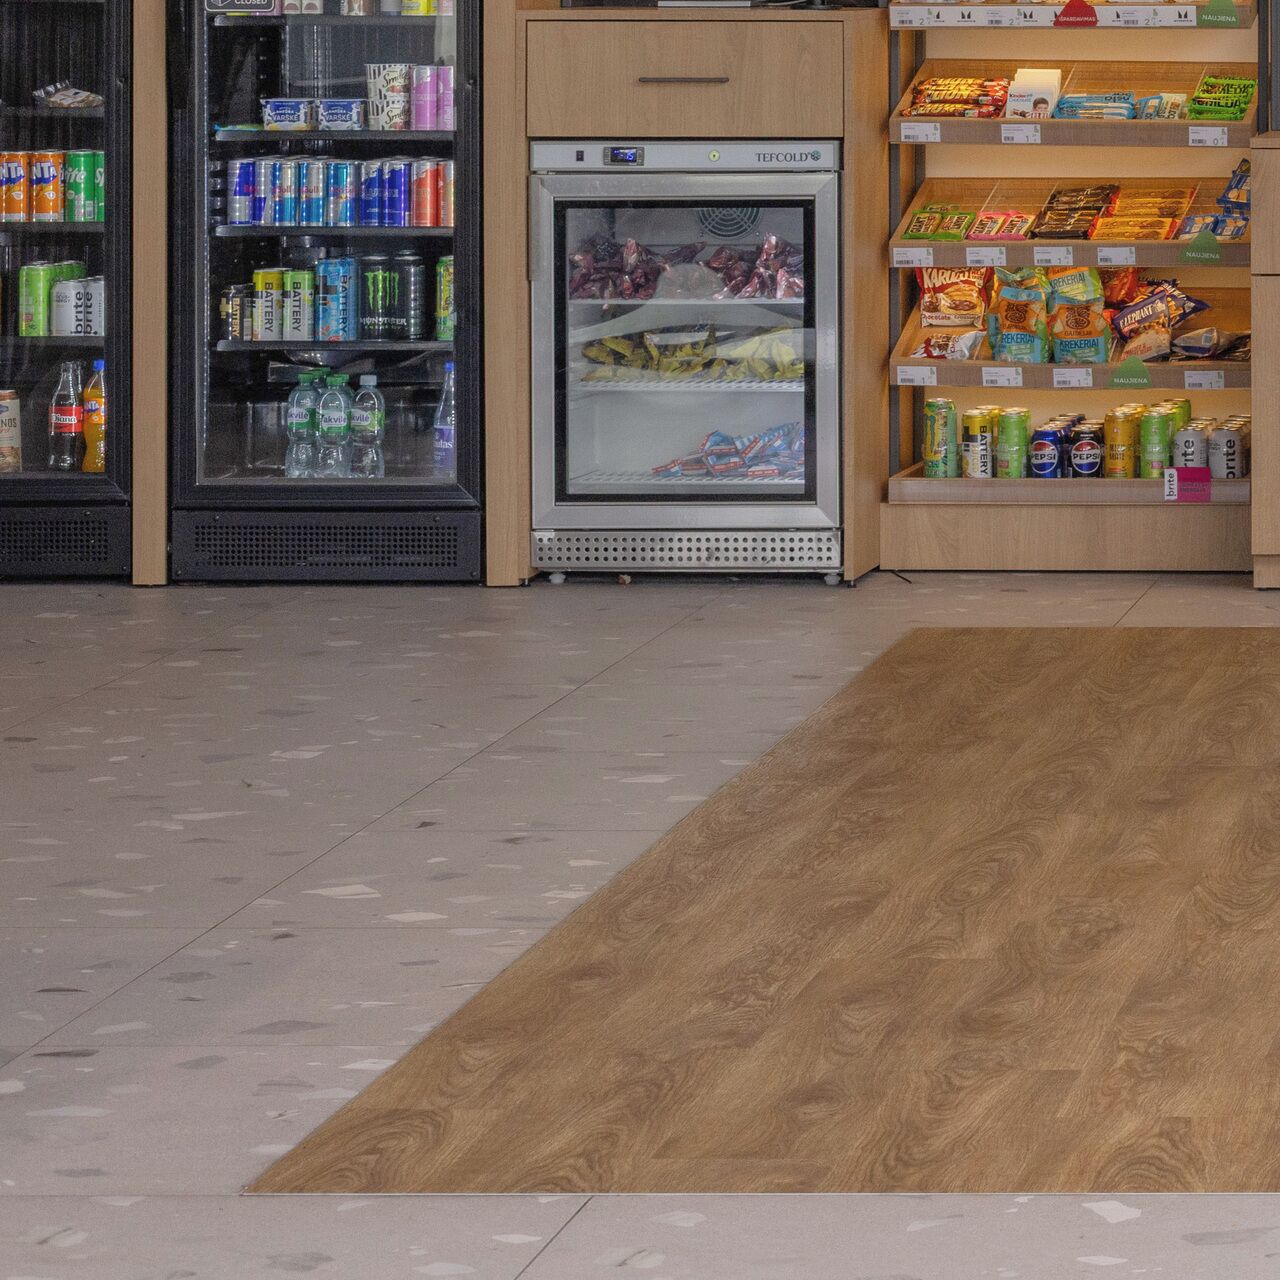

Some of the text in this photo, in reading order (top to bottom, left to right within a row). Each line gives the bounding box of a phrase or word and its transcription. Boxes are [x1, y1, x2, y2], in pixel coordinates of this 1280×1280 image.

[1202, 14, 1237, 22] NAUJIENA
[756, 152, 808, 162] TEFCOLD
[1186, 251, 1219, 259] NAUJIENA
[264, 282, 274, 333] BATTERY
[293, 281, 302, 333] BATTERY
[340, 275, 349, 335] BATTERY
[1119, 304, 1153, 329] ELEPHANT
[979, 425, 988, 475] BATTERY
[1030, 453, 1056, 461] PEPSI
[1073, 453, 1100, 461] PEPSI
[1166, 472, 1176, 497] brite
